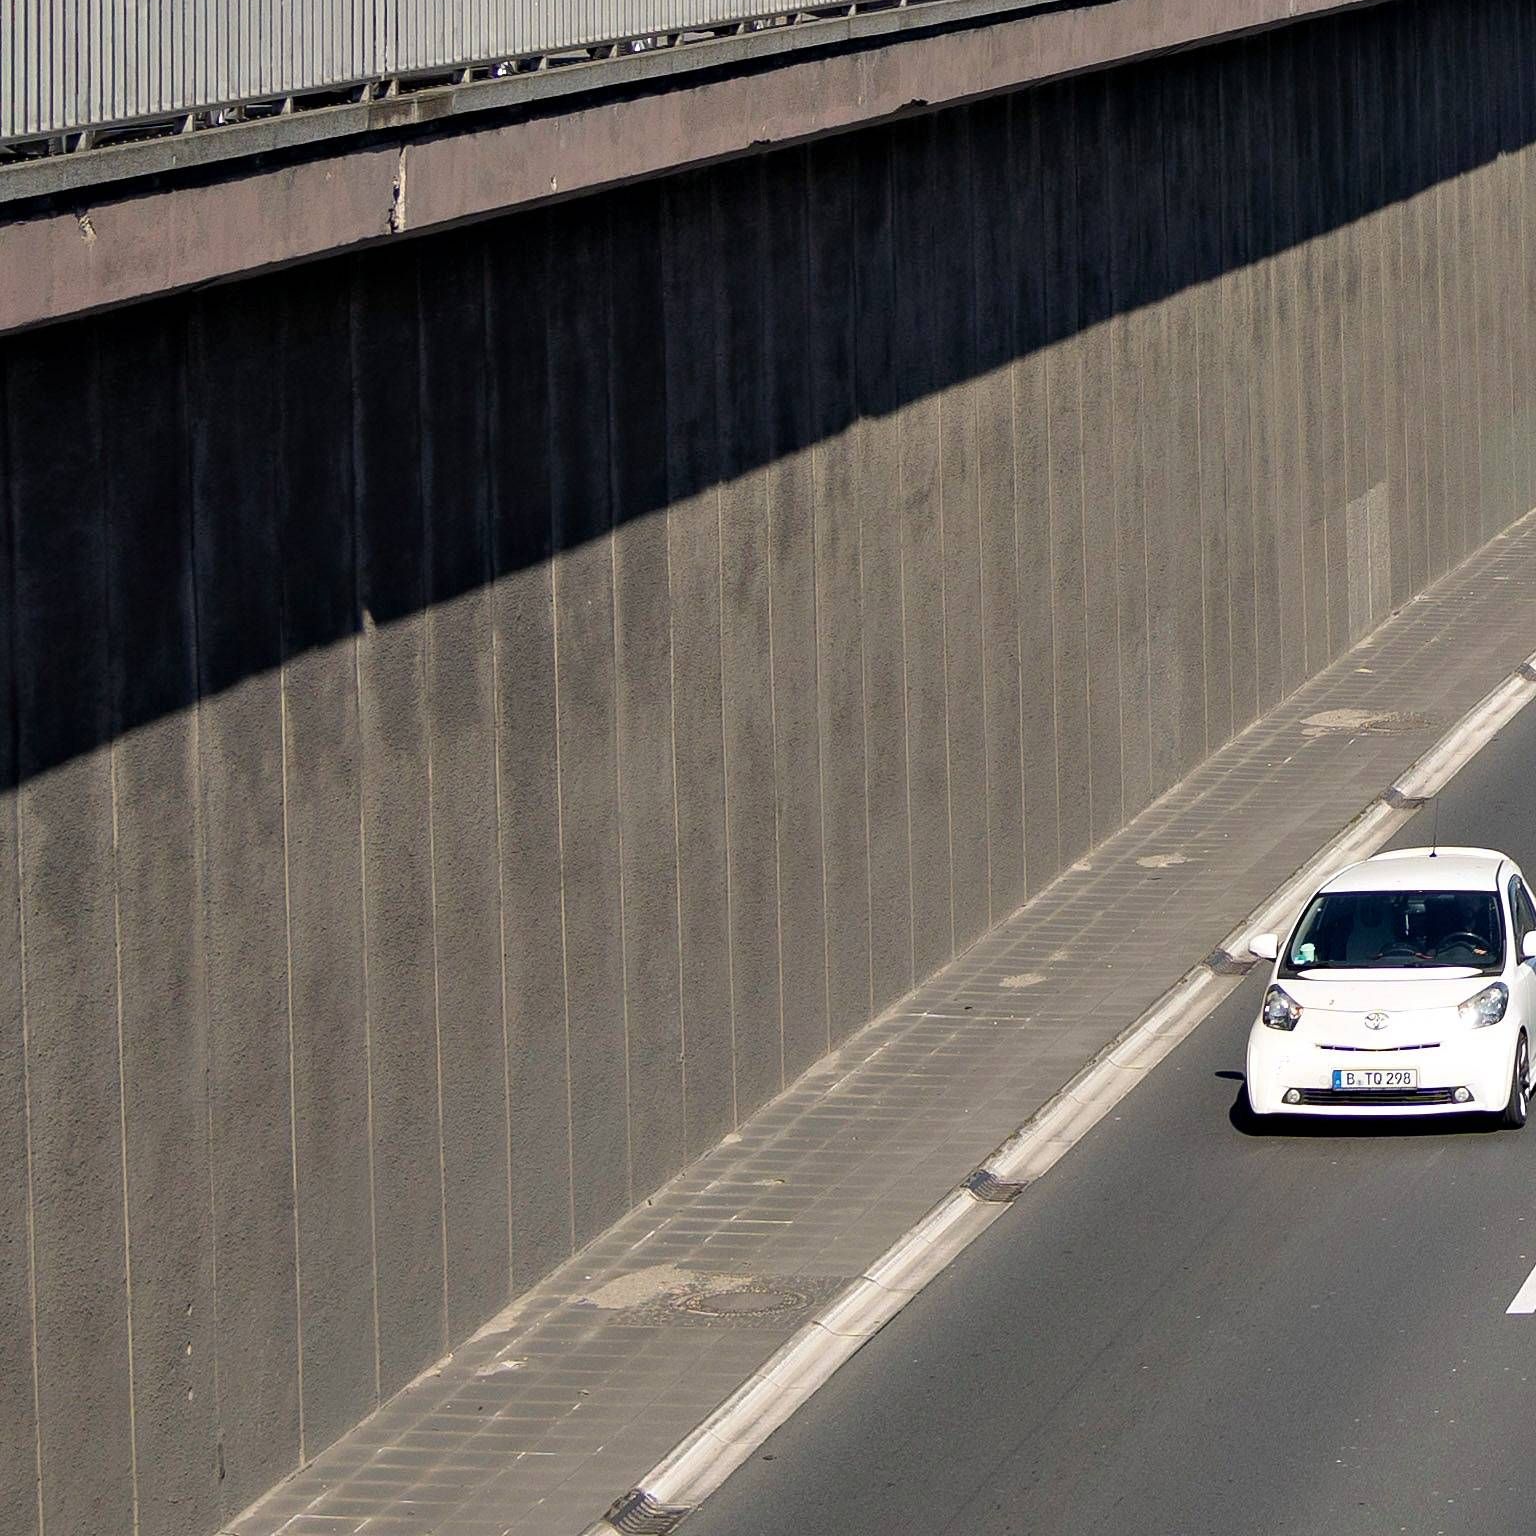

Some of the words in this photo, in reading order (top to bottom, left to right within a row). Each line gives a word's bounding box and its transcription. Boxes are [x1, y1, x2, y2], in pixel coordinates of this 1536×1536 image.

[1346, 1072, 1355, 1085] B
[1365, 1072, 1382, 1085] TQ
[1386, 1072, 1411, 1085] 298
